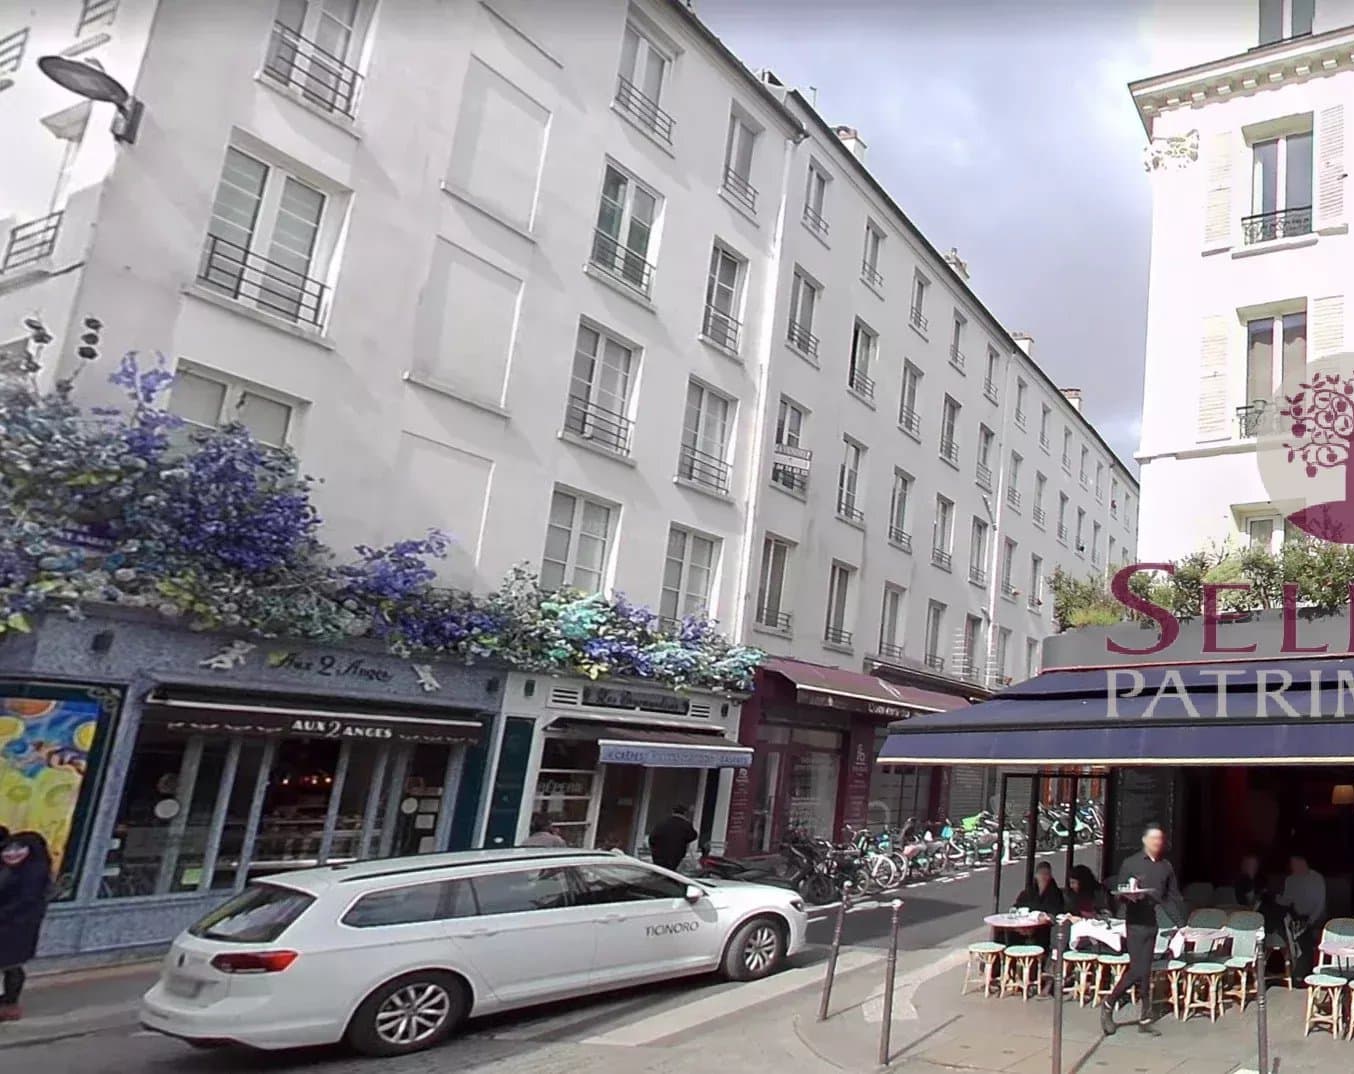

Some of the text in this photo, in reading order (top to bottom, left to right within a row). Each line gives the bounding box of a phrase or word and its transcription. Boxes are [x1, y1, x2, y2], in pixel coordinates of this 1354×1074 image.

[317, 655, 335, 676] 2
[338, 659, 394, 682] Anges
[291, 719, 393, 739] AUX 2 ANGES
